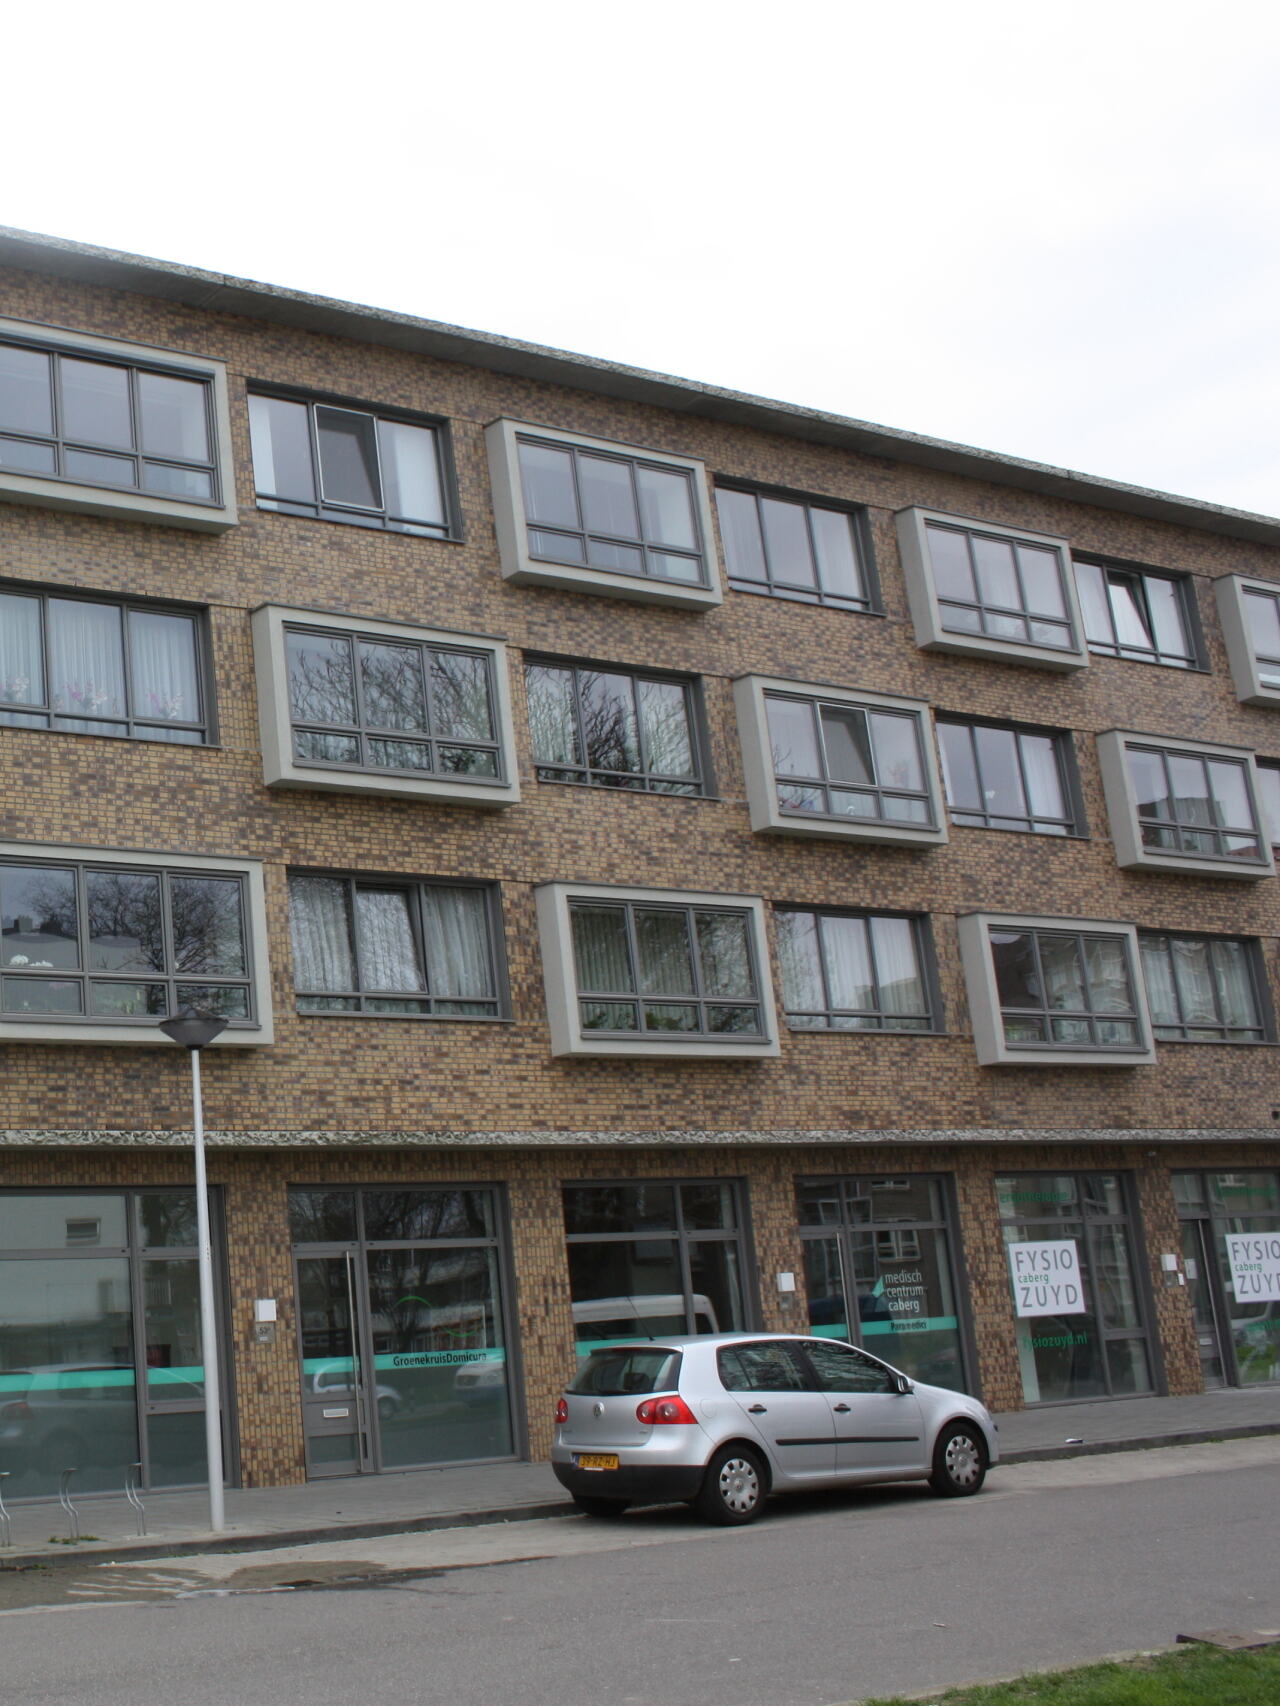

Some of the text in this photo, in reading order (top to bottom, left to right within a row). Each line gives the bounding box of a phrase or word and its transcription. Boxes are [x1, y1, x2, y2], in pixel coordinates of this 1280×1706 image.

[1231, 1240, 1280, 1261] FYSIO
[1015, 1249, 1073, 1272] FYSIO
[1234, 1263, 1262, 1272] caberg
[885, 1268, 922, 1284] medisch
[1018, 1273, 1049, 1285] caberg
[886, 1286, 924, 1298] centrum
[1020, 1284, 1078, 1308] ZUYD
[888, 1298, 920, 1313] caberg
[393, 1352, 487, 1367] GroenekruisDomicura
